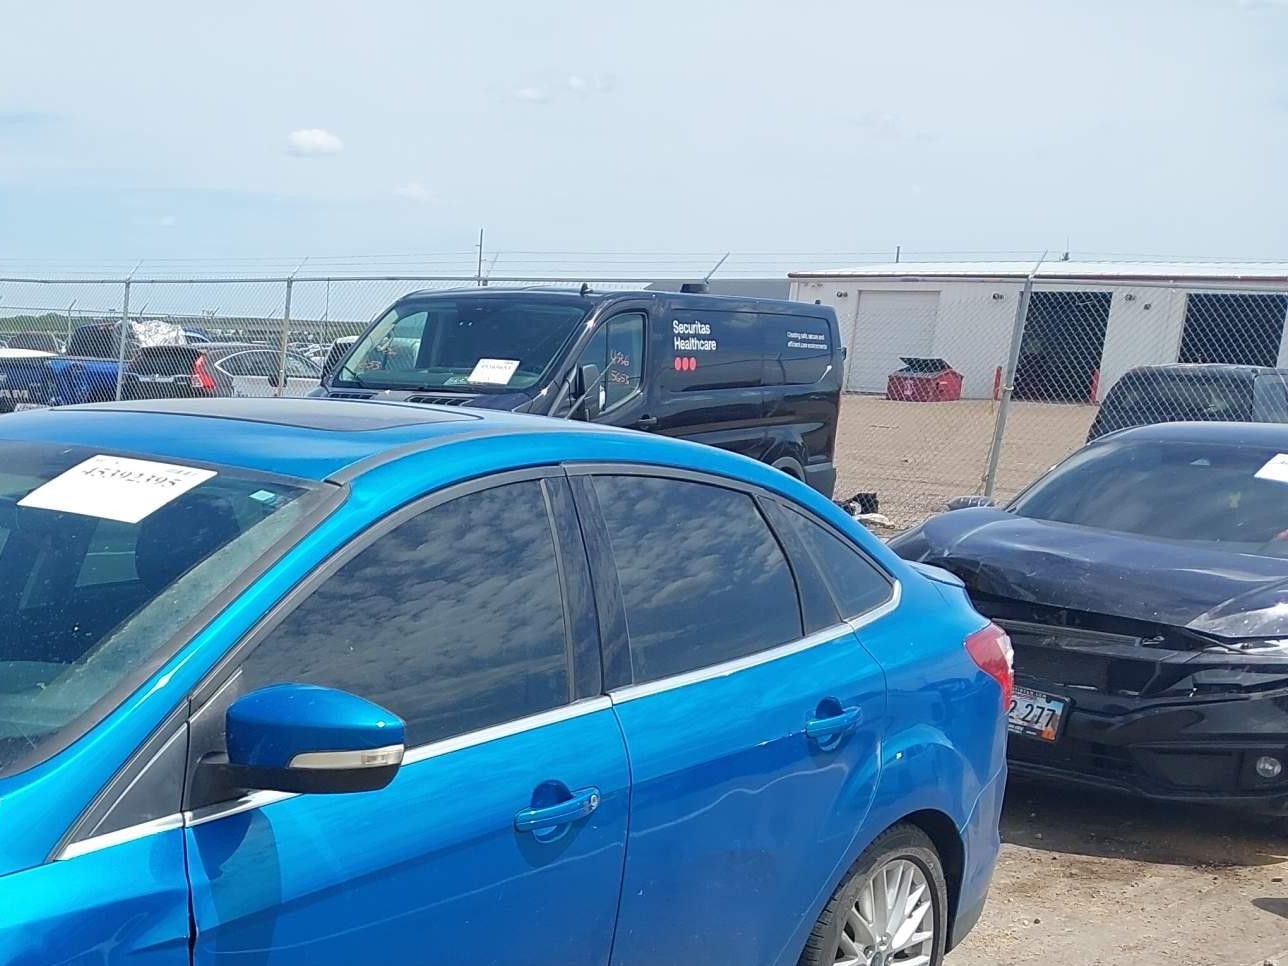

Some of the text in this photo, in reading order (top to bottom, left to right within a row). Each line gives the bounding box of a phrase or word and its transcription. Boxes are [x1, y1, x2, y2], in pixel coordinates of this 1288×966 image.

[673, 320, 711, 335] Securitas
[674, 337, 717, 351] Healthcare
[1022, 703, 1057, 728] 277
